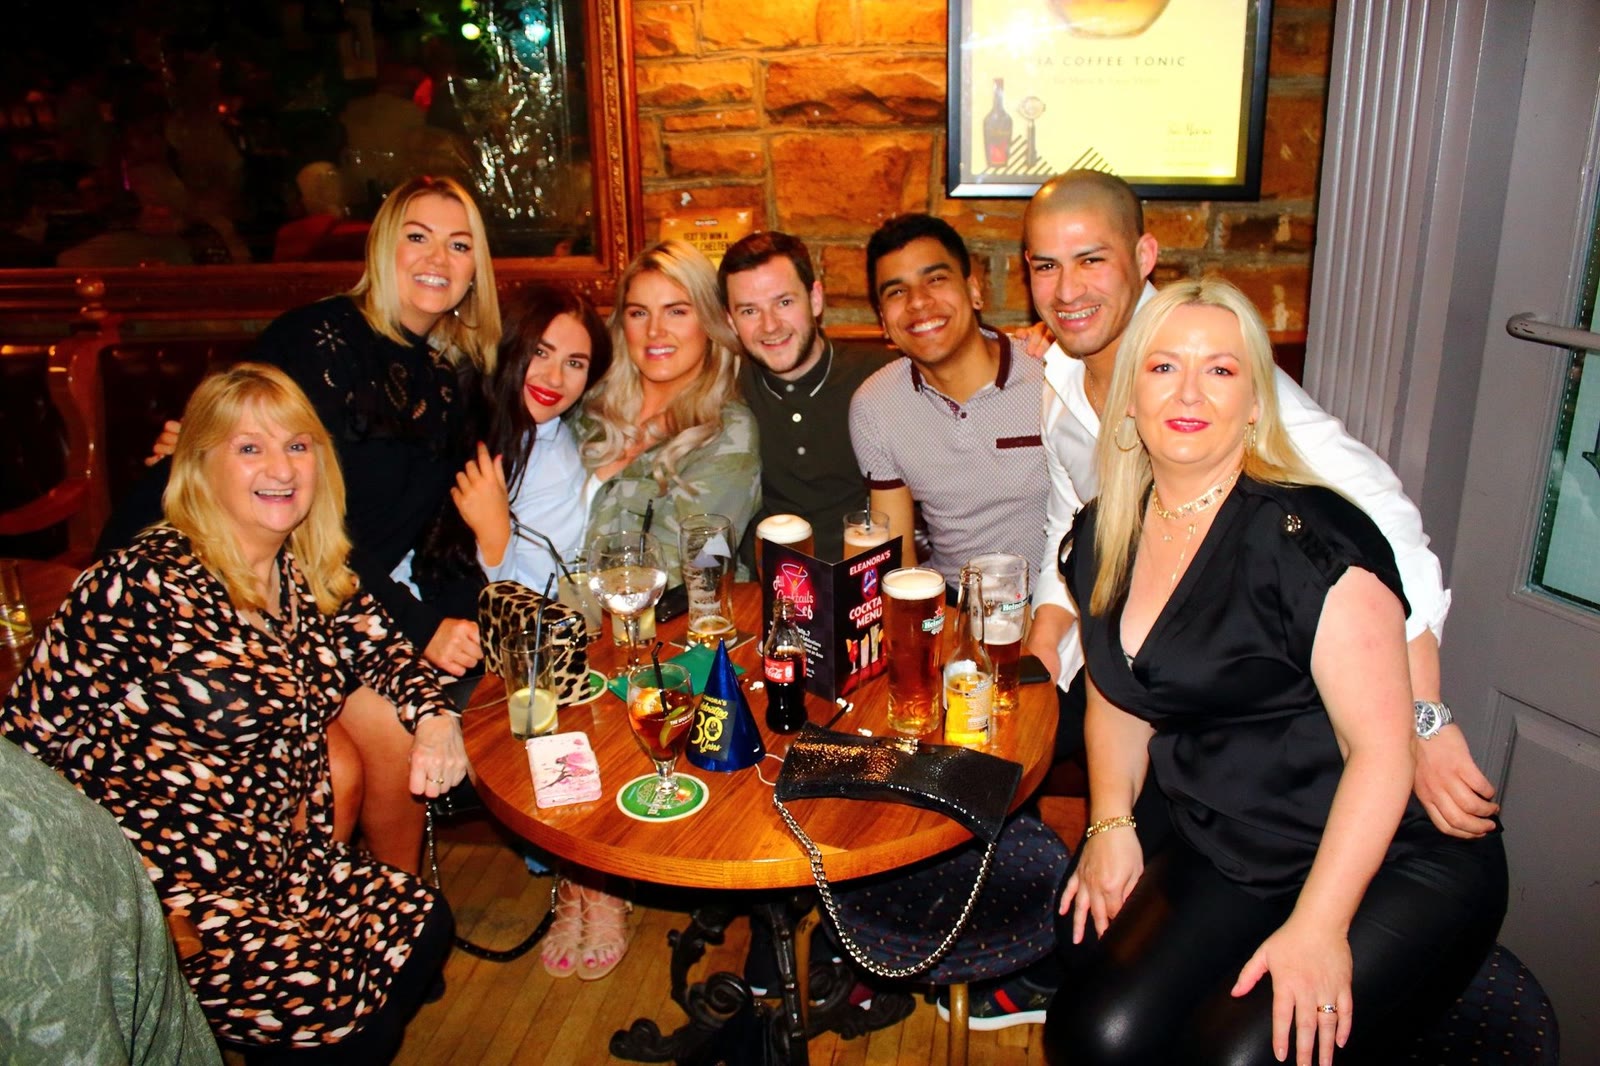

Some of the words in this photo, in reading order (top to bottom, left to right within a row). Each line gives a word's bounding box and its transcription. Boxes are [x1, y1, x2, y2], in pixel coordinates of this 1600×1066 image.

[1062, 56, 1123, 66] COFFEE
[1135, 56, 1185, 67] TONIC
[849, 549, 891, 576] ELEANORA'S
[773, 575, 785, 591] All
[849, 596, 882, 620] COCKTA
[856, 607, 883, 629] MENU
[691, 711, 723, 744] 30
